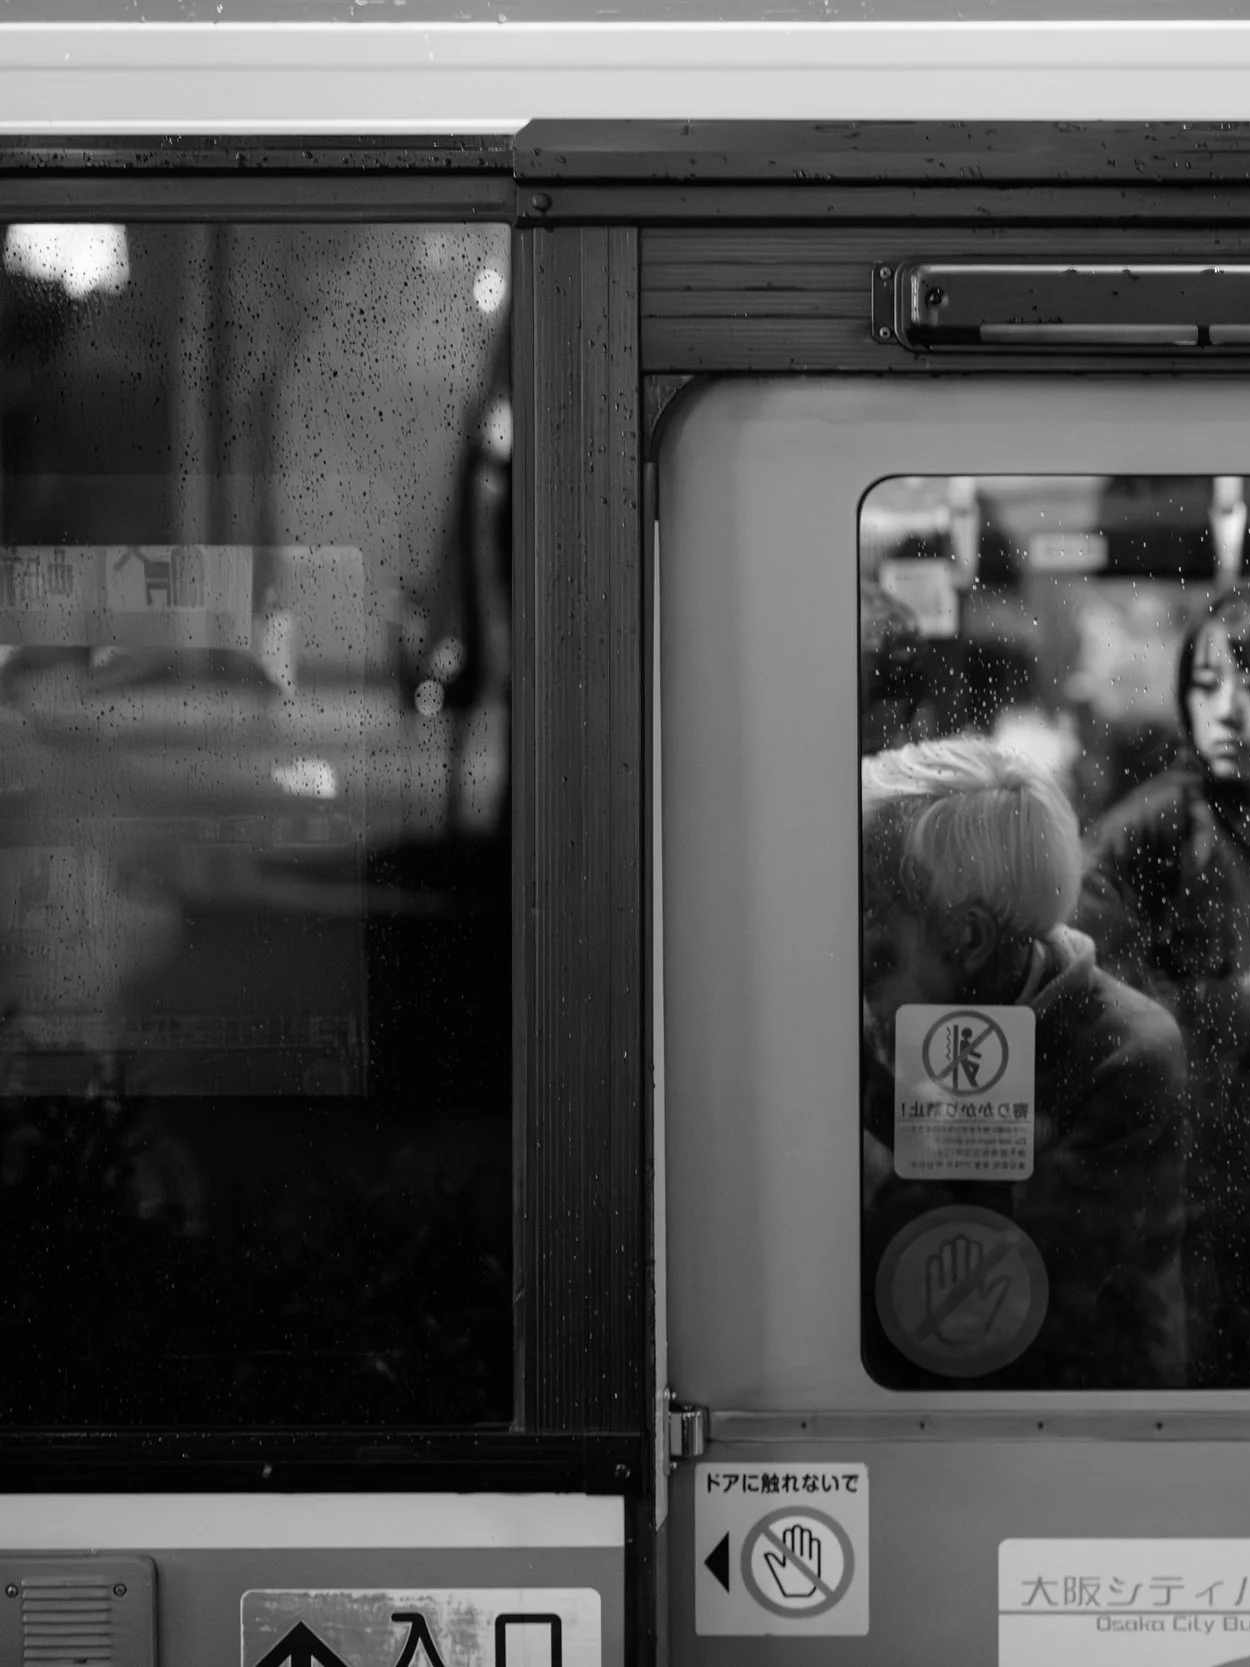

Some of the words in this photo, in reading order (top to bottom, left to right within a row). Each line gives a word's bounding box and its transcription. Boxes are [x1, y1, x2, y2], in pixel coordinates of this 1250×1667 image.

[707, 1472, 859, 1494] ドアに触れないで
[1096, 1615, 1165, 1632] Osaka
[1172, 1614, 1214, 1635] City
